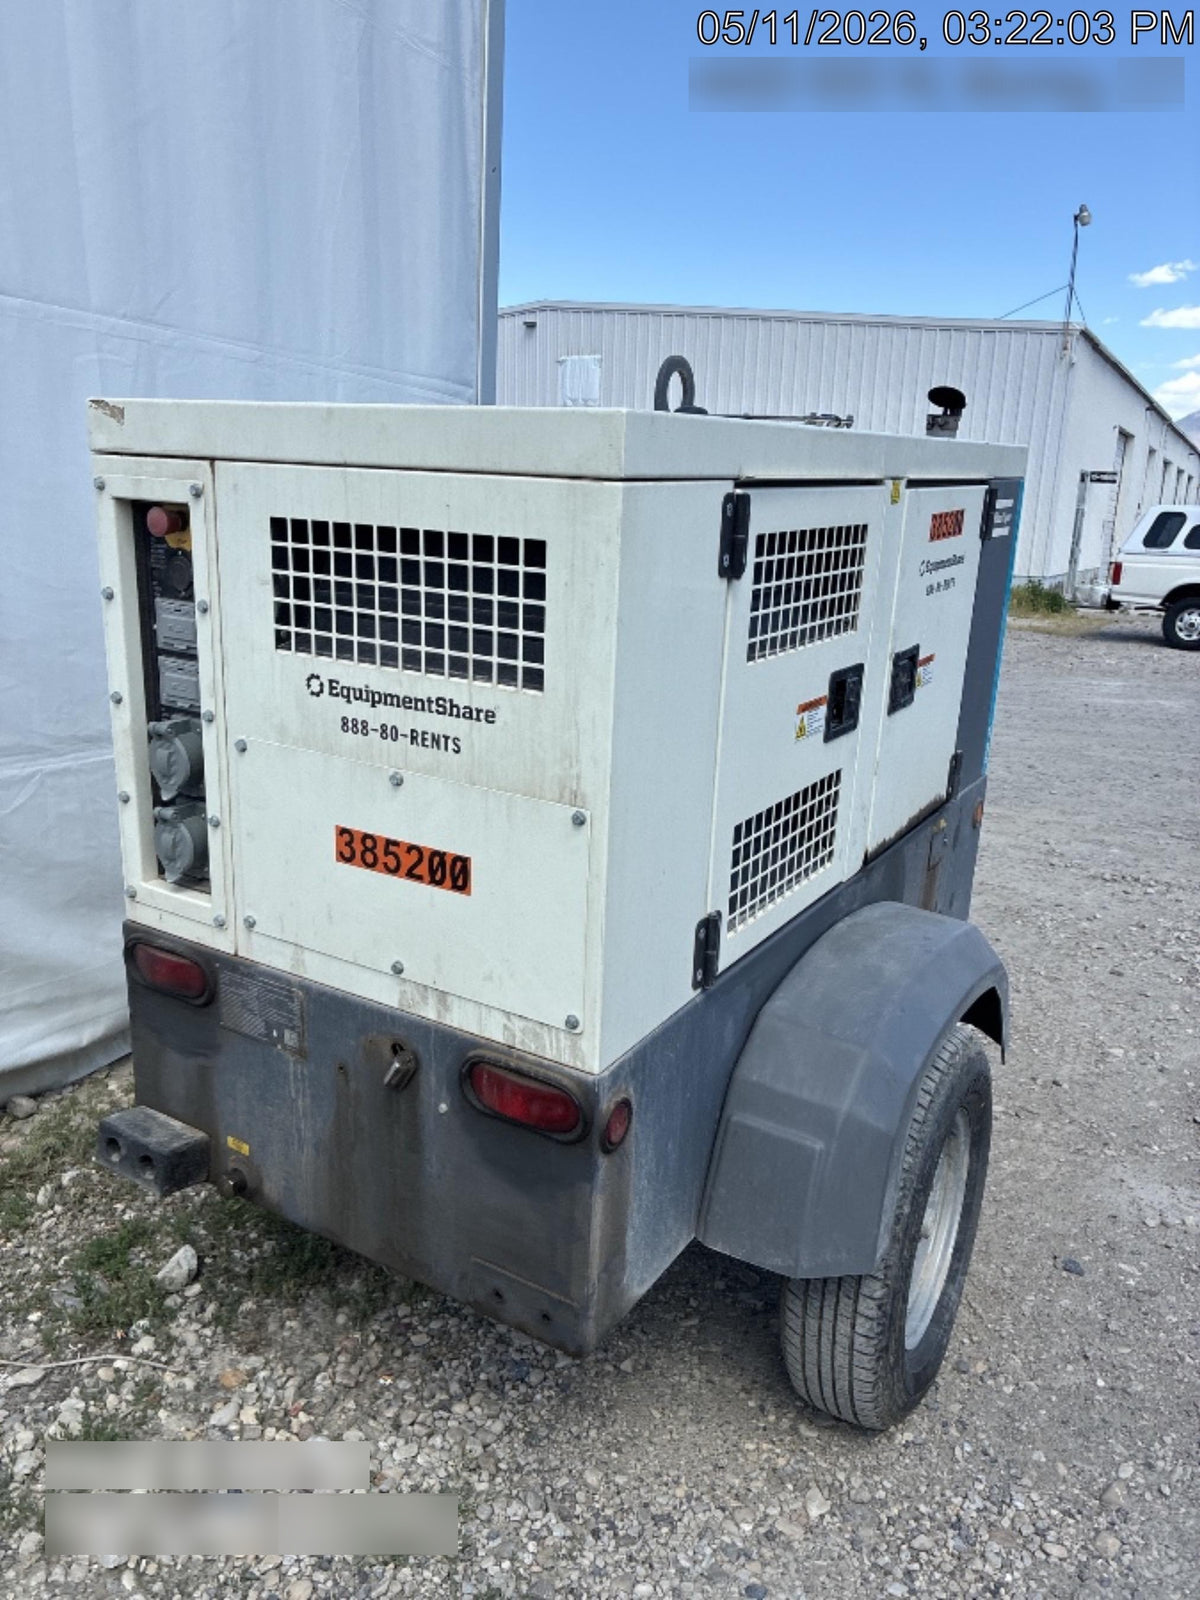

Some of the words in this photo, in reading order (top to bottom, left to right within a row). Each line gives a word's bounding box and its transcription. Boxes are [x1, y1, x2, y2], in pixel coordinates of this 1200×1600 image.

[327, 678, 497, 725] EquipmentShare
[340, 715, 462, 755] 888-80-RENTS
[337, 826, 470, 892] 385200
